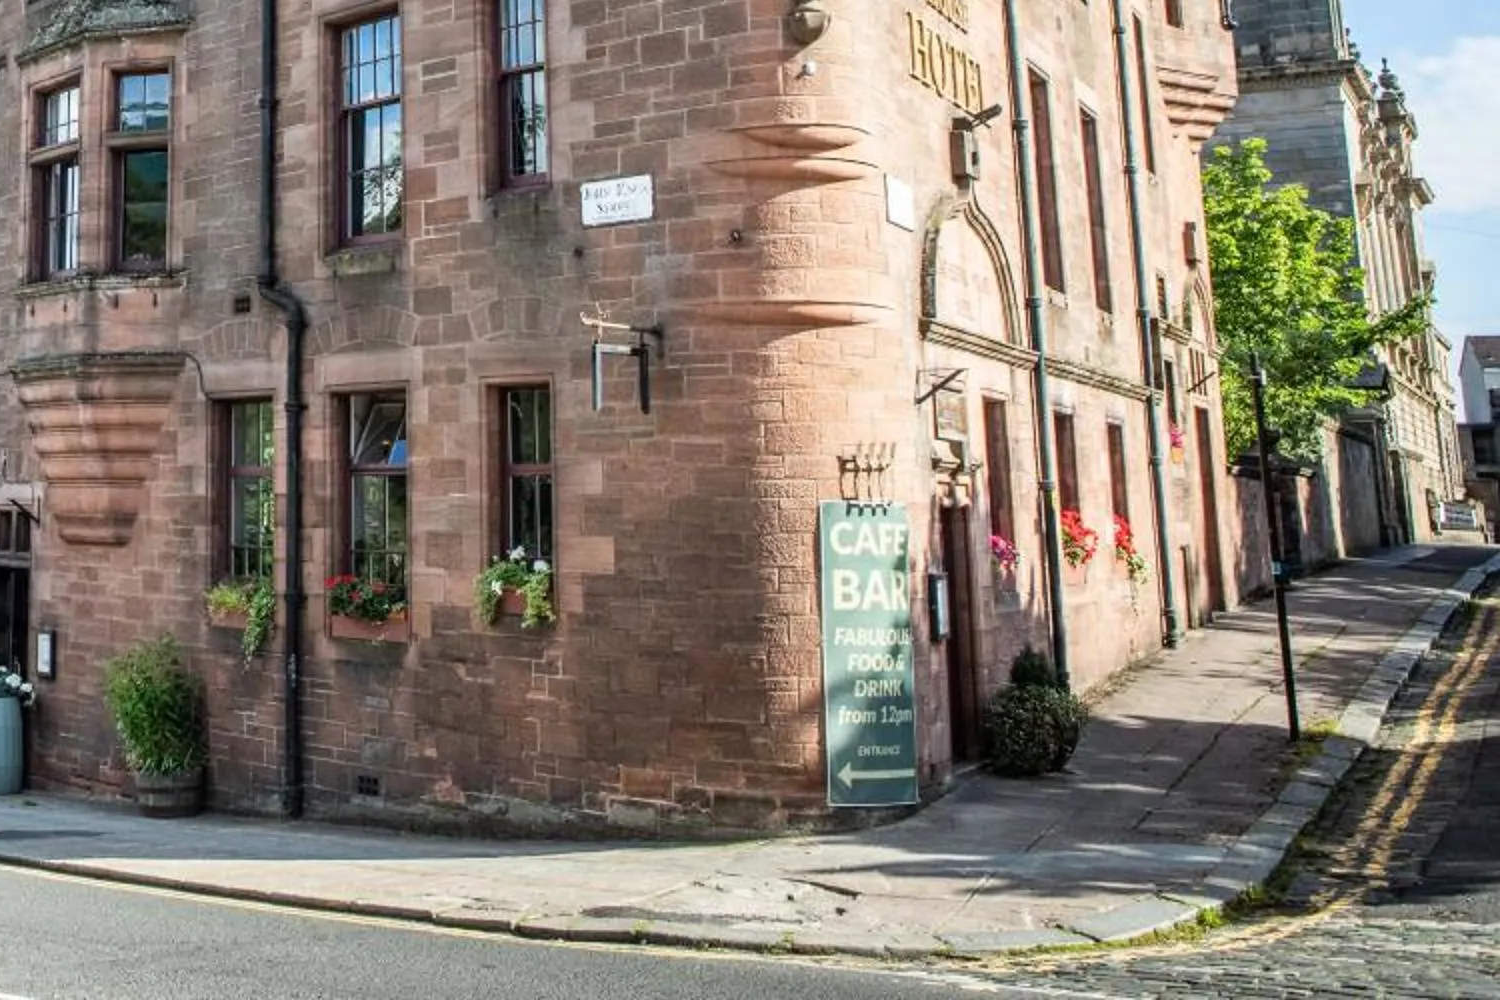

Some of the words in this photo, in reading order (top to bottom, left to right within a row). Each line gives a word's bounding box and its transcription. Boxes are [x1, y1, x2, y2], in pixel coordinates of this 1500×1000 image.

[829, 521, 907, 557] CAFE
[833, 568, 907, 611] BAR
[847, 654, 894, 672] FOOD
[854, 679, 903, 697] DRINK
[838, 705, 877, 725] from
[880, 705, 913, 726] 12pm
